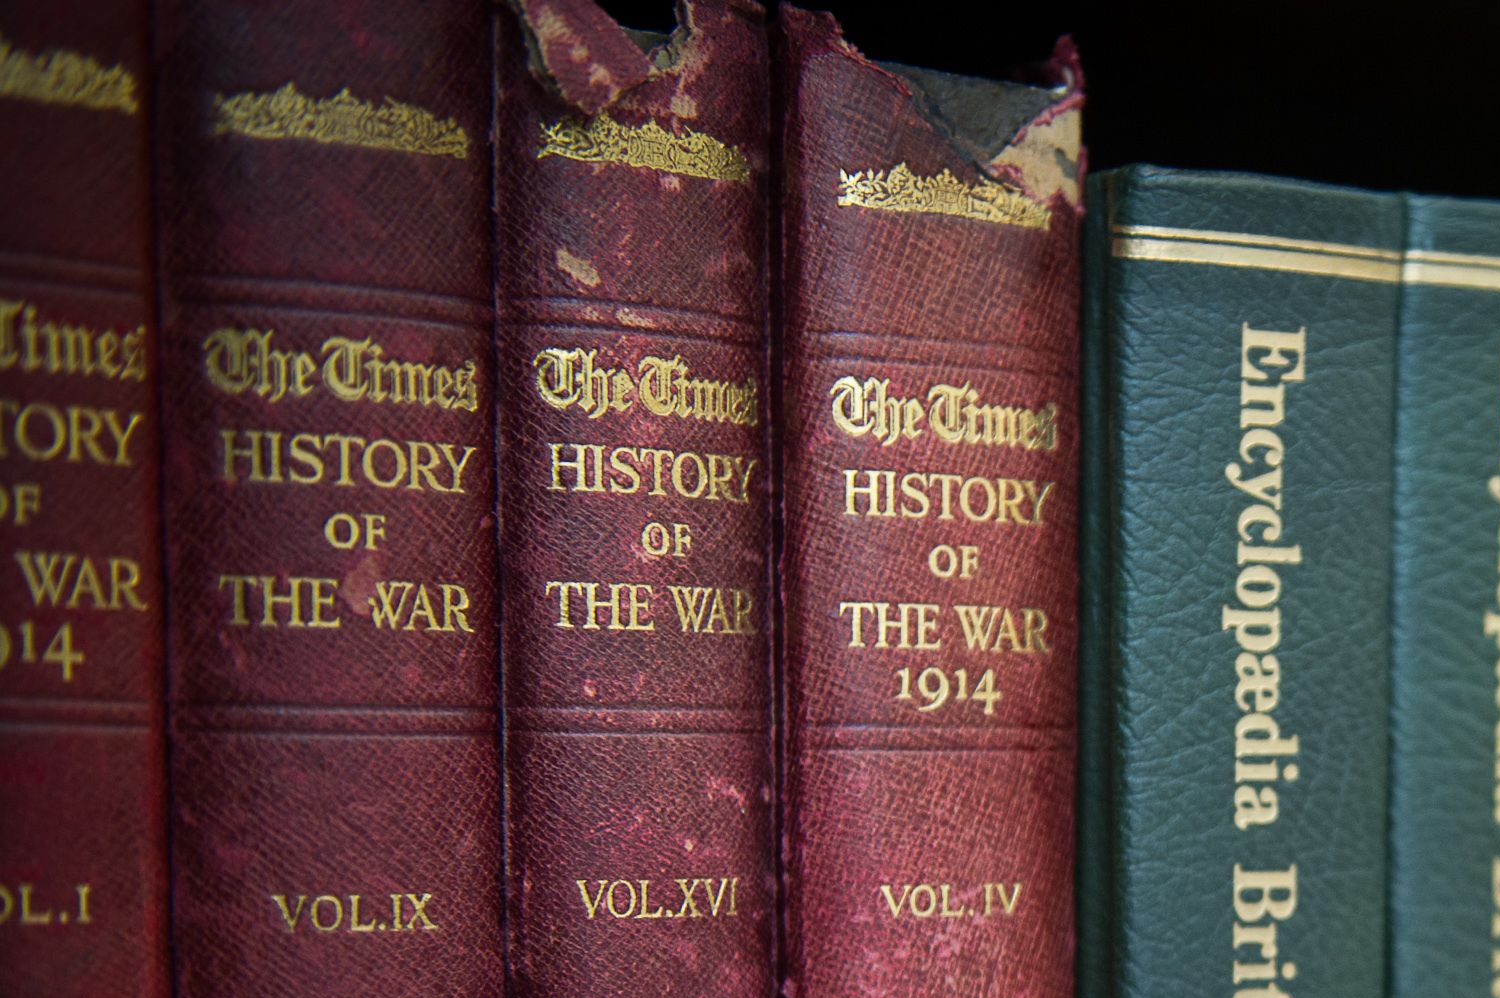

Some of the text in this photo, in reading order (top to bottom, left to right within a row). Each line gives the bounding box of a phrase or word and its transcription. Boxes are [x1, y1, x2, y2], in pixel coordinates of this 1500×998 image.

[205, 330, 479, 412] The Times
[534, 348, 757, 425] The Times
[830, 376, 1056, 451] The Times
[222, 430, 476, 494] HISTORY
[546, 443, 757, 502] HISTORY
[0, 486, 41, 525] F
[842, 469, 1054, 525] HISTORY
[325, 512, 386, 550] OF
[642, 523, 692, 557] OF
[16, 552, 149, 611] WAR
[929, 545, 979, 579] OF
[1222, 322, 1306, 830] Encyclopædia
[219, 576, 474, 632] THE WAR
[546, 581, 757, 634] THE WAR
[839, 602, 1049, 653] THE WAR
[897, 667, 1001, 715] 1914
